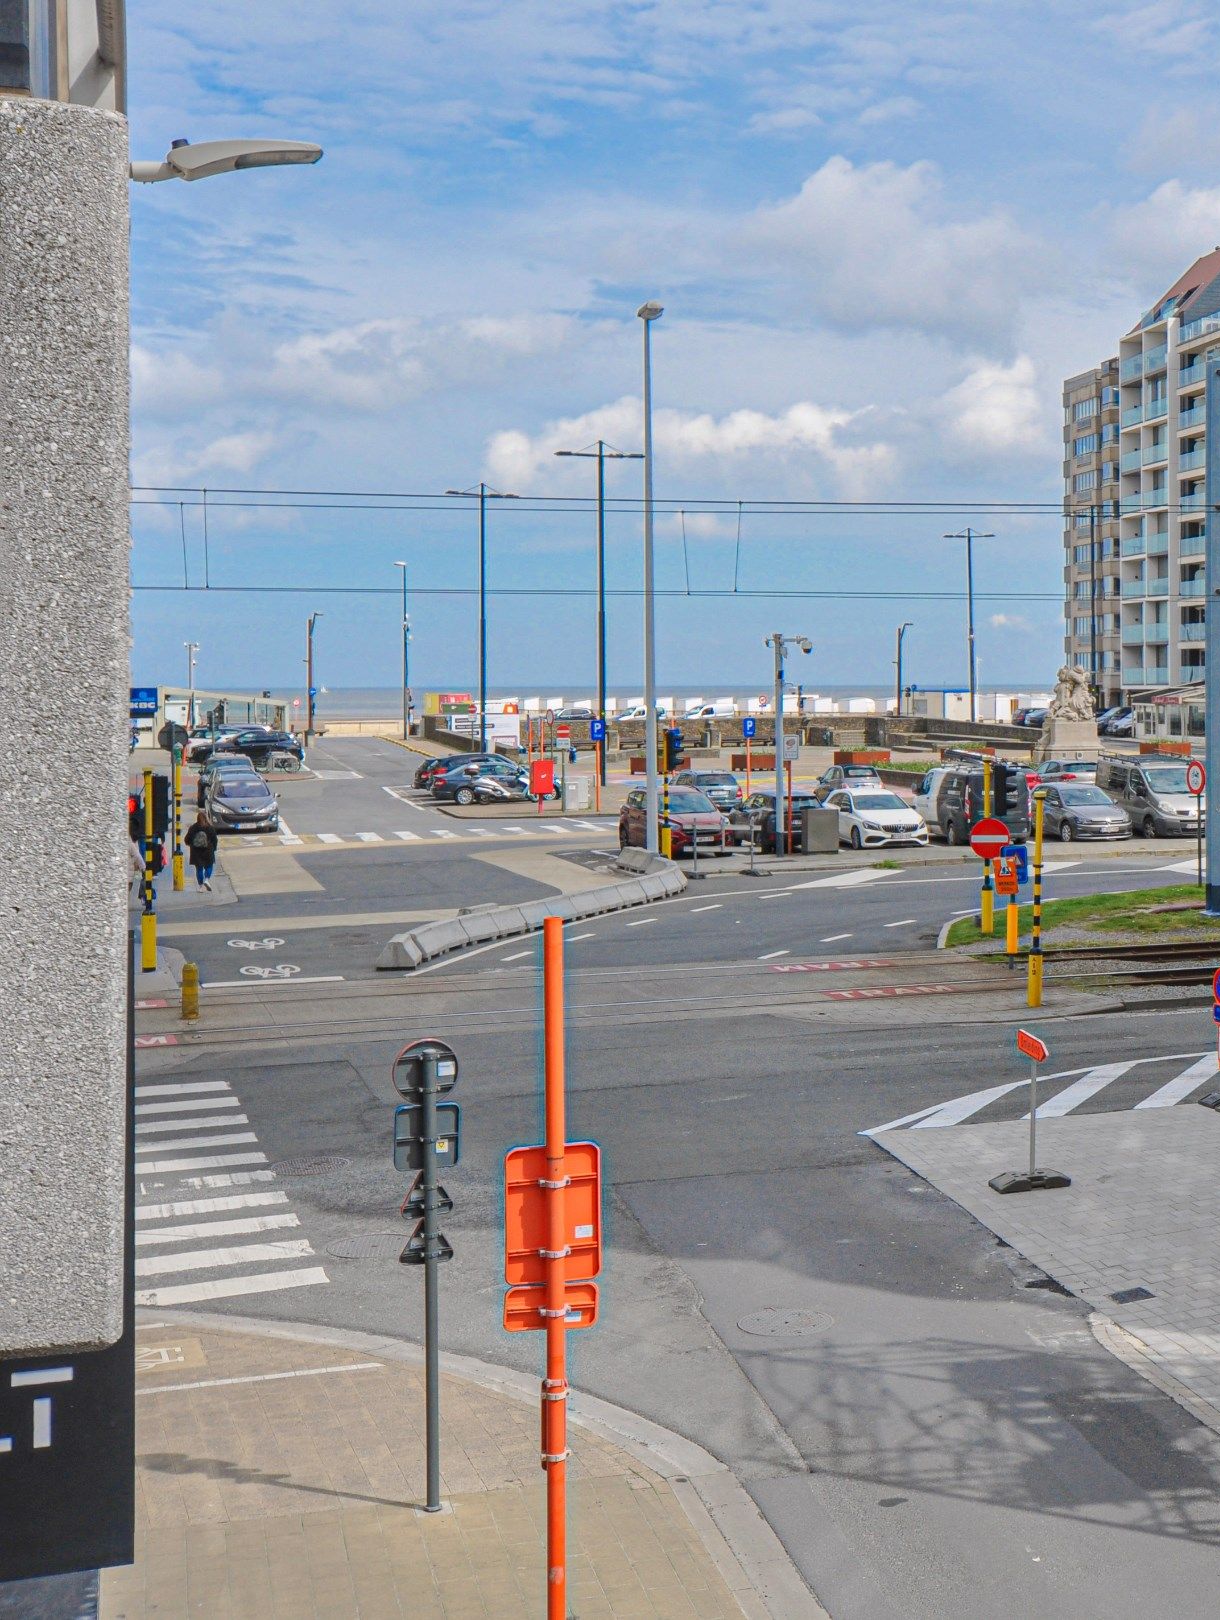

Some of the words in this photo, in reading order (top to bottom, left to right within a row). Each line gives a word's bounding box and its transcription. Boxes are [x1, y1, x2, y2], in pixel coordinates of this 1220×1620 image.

[594, 722, 602, 733] P
[746, 720, 753, 731] P
[772, 959, 889, 972] TRAM
[829, 985, 952, 999] TRAM
